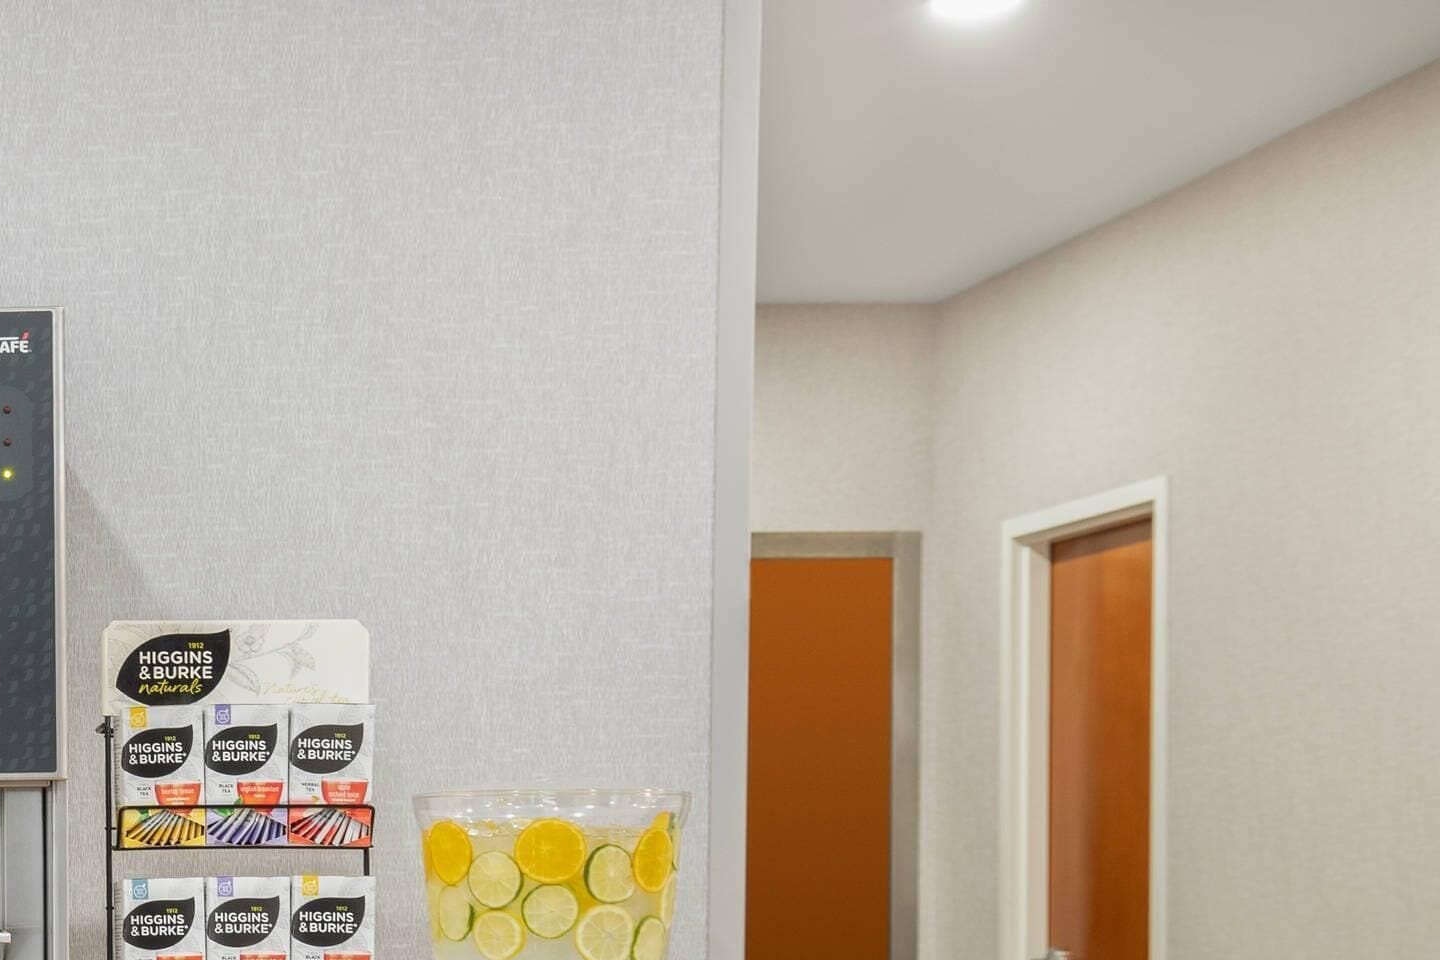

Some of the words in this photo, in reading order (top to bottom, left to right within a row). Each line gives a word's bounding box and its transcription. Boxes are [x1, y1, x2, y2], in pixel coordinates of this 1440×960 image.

[140, 651, 212, 664] HIGGINS
[139, 680, 202, 694] naturals
[129, 742, 182, 754] HIGGINS
[213, 741, 266, 750] HIGGINS
[298, 738, 352, 749] HIGGINS
[131, 915, 184, 924] HIGGINS
[215, 913, 268, 922] HIGGINS
[300, 912, 353, 922] HIGGINS
